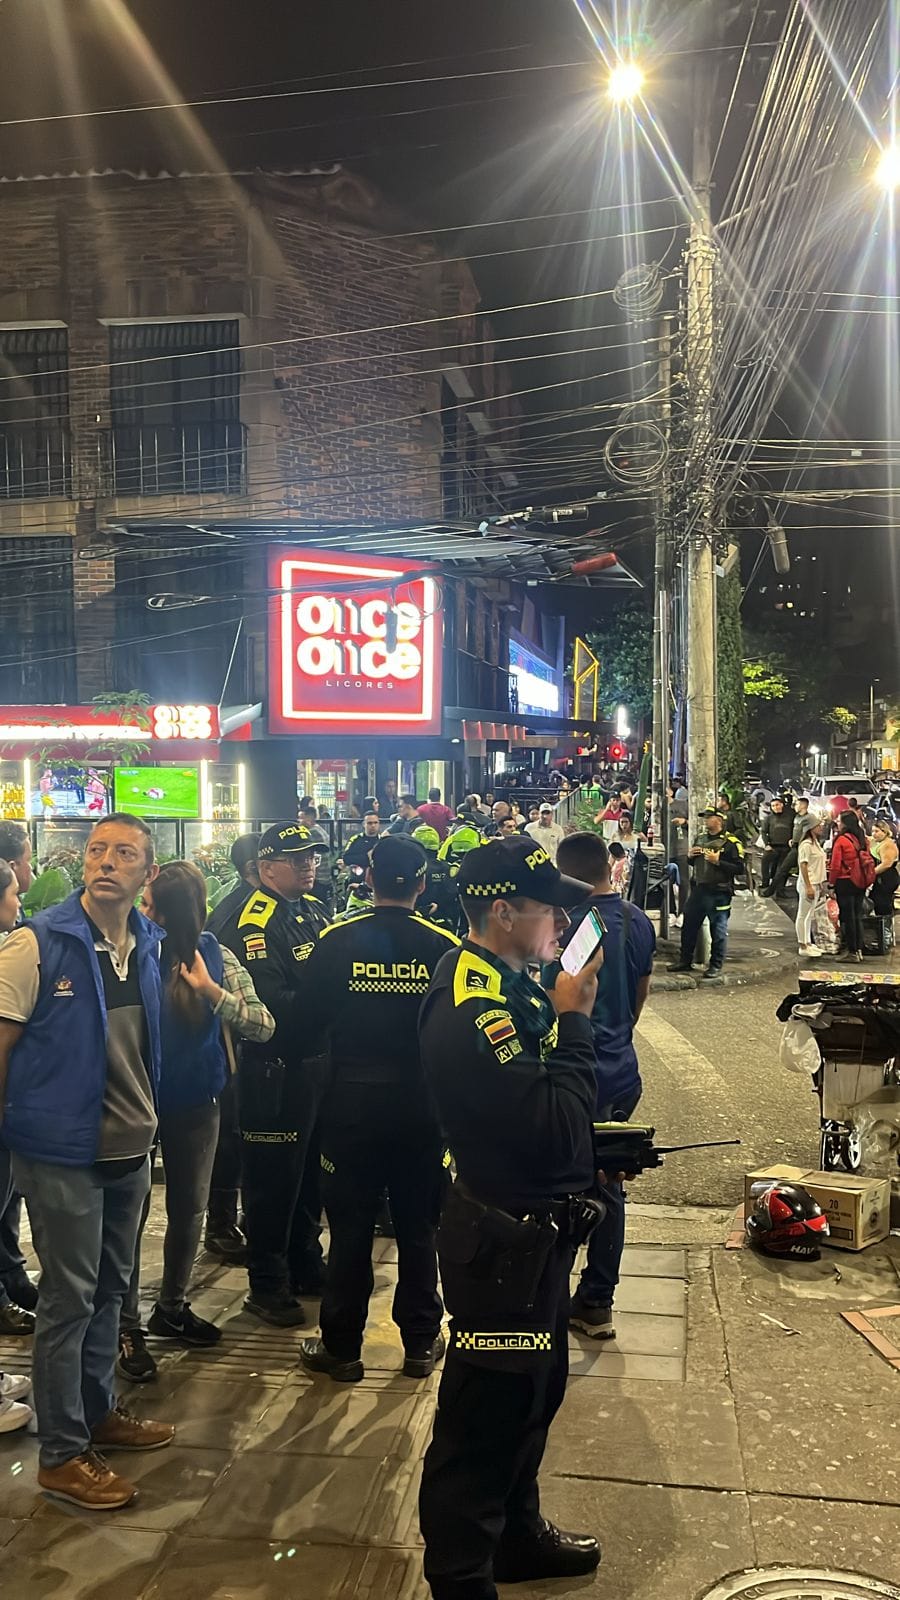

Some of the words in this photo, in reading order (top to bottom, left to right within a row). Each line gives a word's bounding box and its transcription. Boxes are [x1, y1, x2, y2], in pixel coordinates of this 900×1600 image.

[326, 679, 394, 689] LICORES
[352, 958, 430, 980] POLICÍA
[829, 1199, 839, 1210] 20
[478, 1335, 531, 1348] POLICÍA
